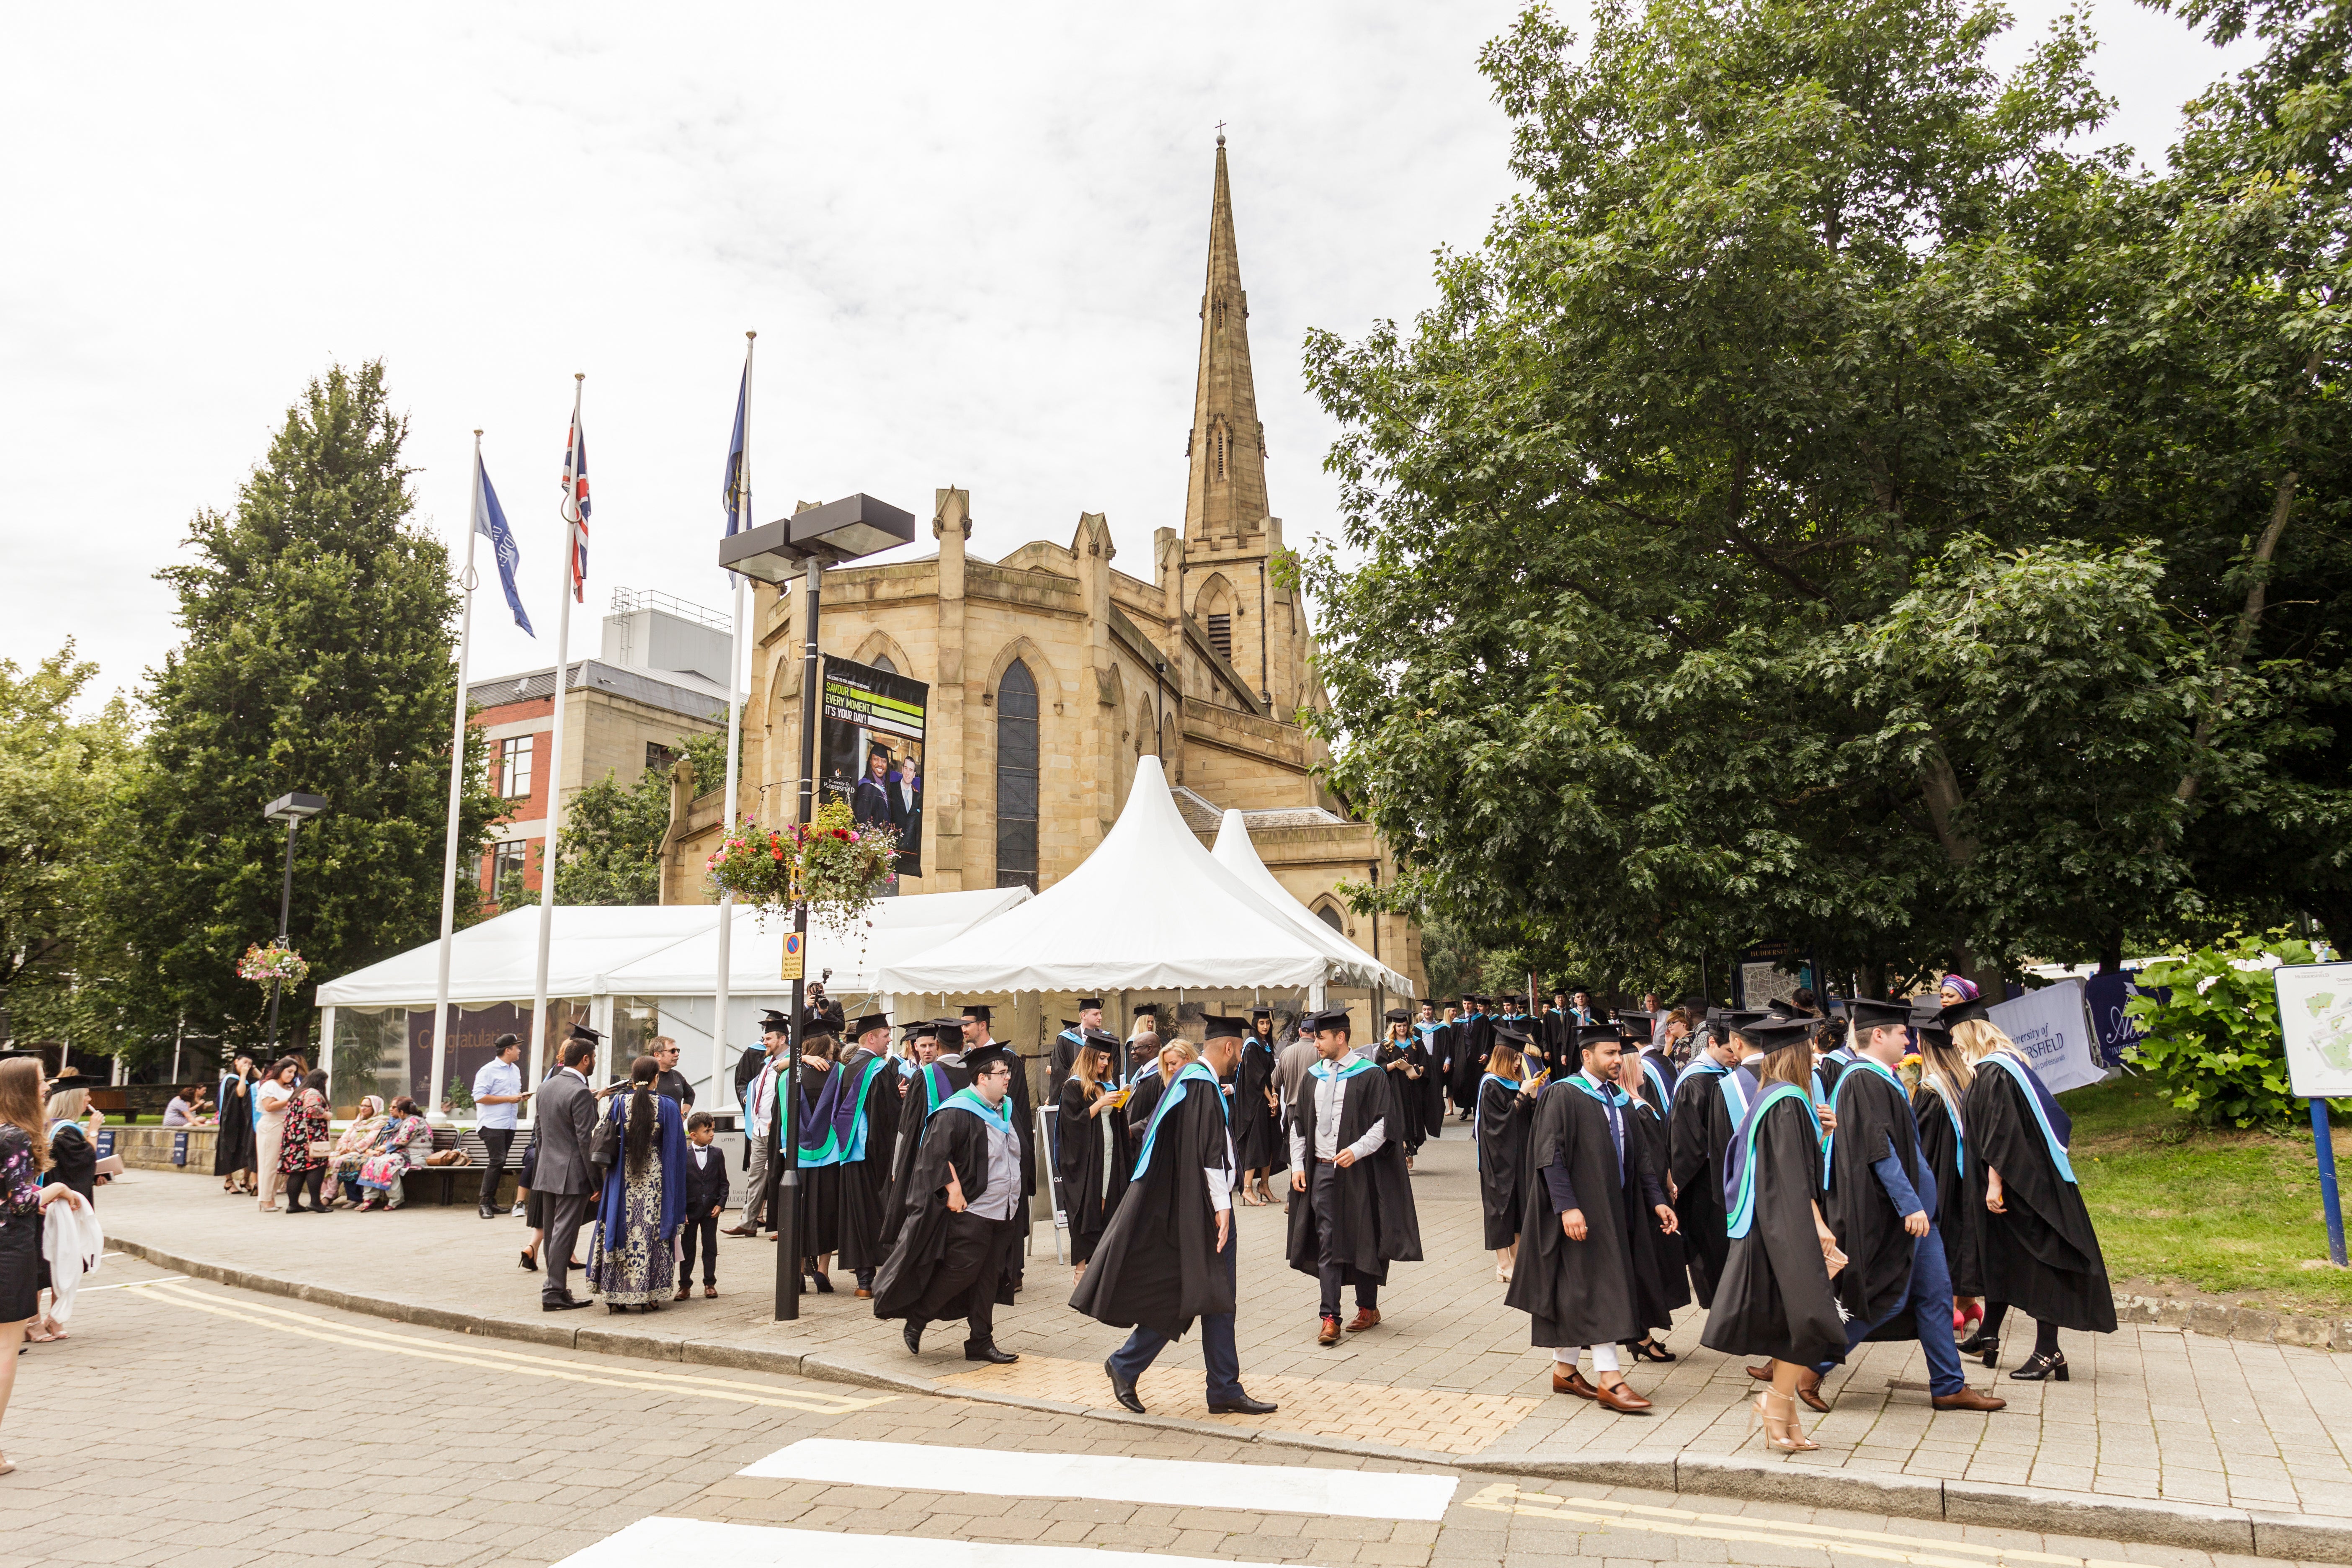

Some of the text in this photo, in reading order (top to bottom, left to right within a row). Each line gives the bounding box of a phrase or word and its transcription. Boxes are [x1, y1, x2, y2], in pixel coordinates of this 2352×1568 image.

[826, 682, 849, 696] SAVOUR
[826, 693, 871, 714] EVERY MOMENT,
[825, 705, 867, 724] IT'S YOUR DAY!
[824, 781, 855, 793] HDDERSFID
[1751, 947, 1800, 957] HUDDERSFID
[2041, 1022, 2048, 1037] of
[418, 1028, 524, 1054] Cgratulatis
